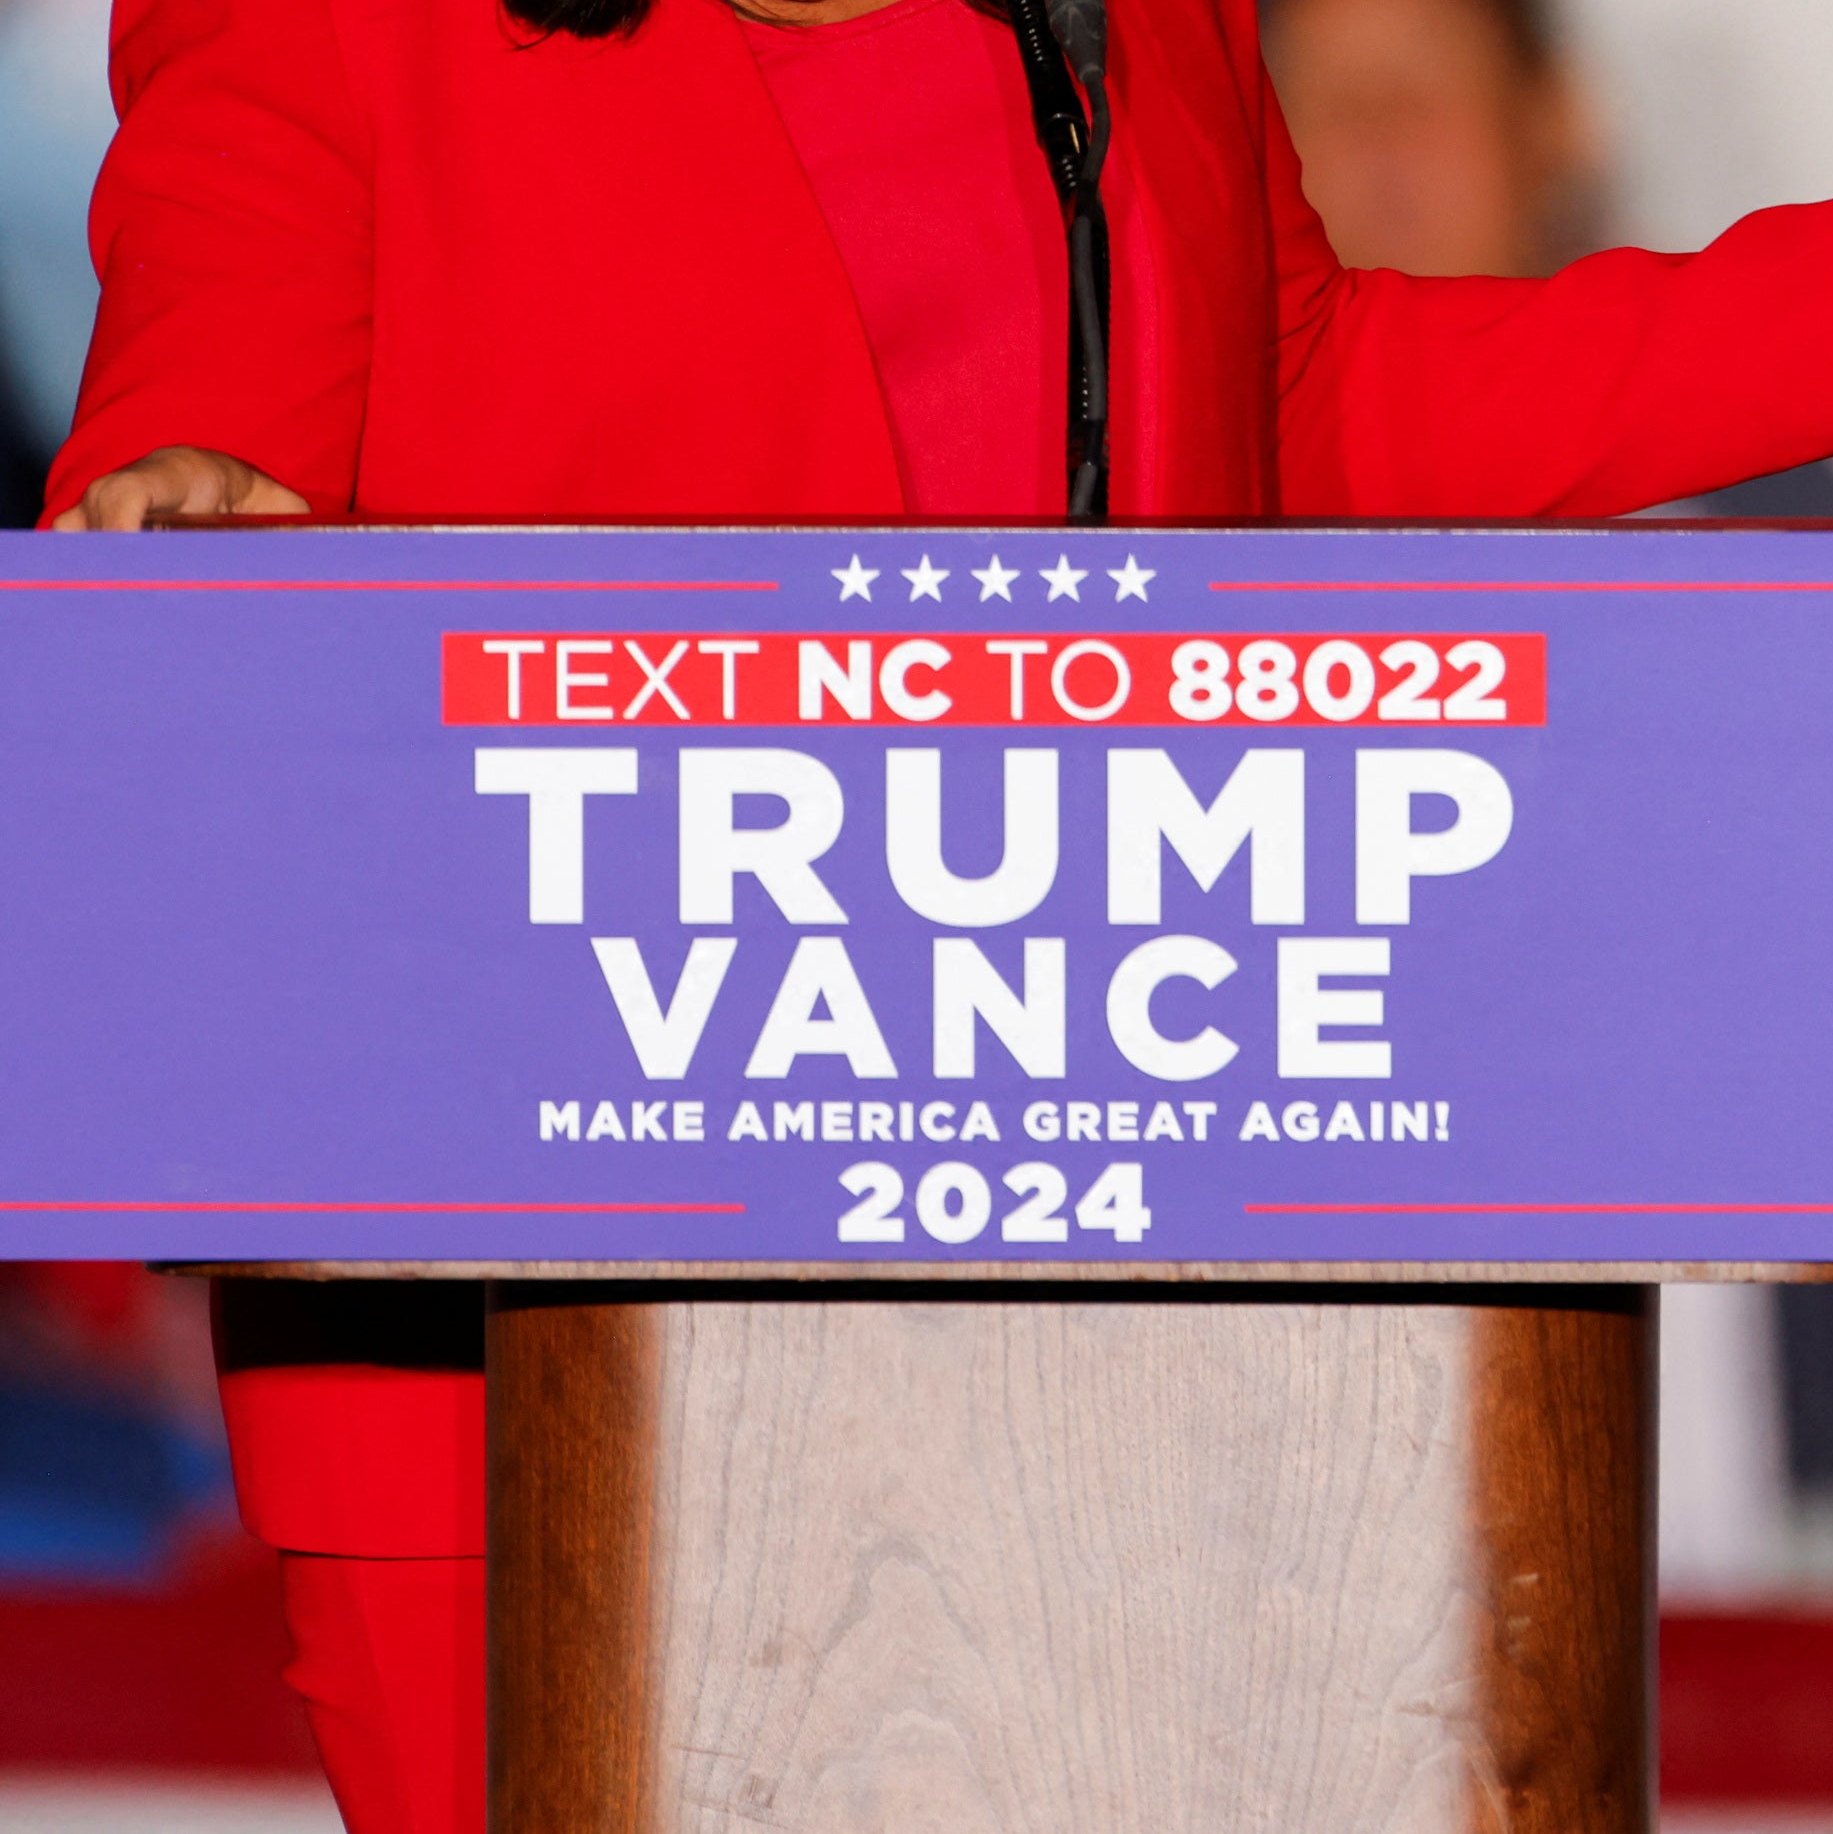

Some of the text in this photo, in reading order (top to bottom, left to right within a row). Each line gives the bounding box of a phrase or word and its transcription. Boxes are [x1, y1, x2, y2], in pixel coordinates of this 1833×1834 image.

[484, 640, 1507, 721] TEXT NC TO 88022
[475, 747, 1513, 927] TRUMP
[591, 934, 1392, 1082] VANCE
[540, 1100, 1450, 1142] MAKE AMERICA GREAT AGAIN!
[837, 1161, 1152, 1244] 2024
